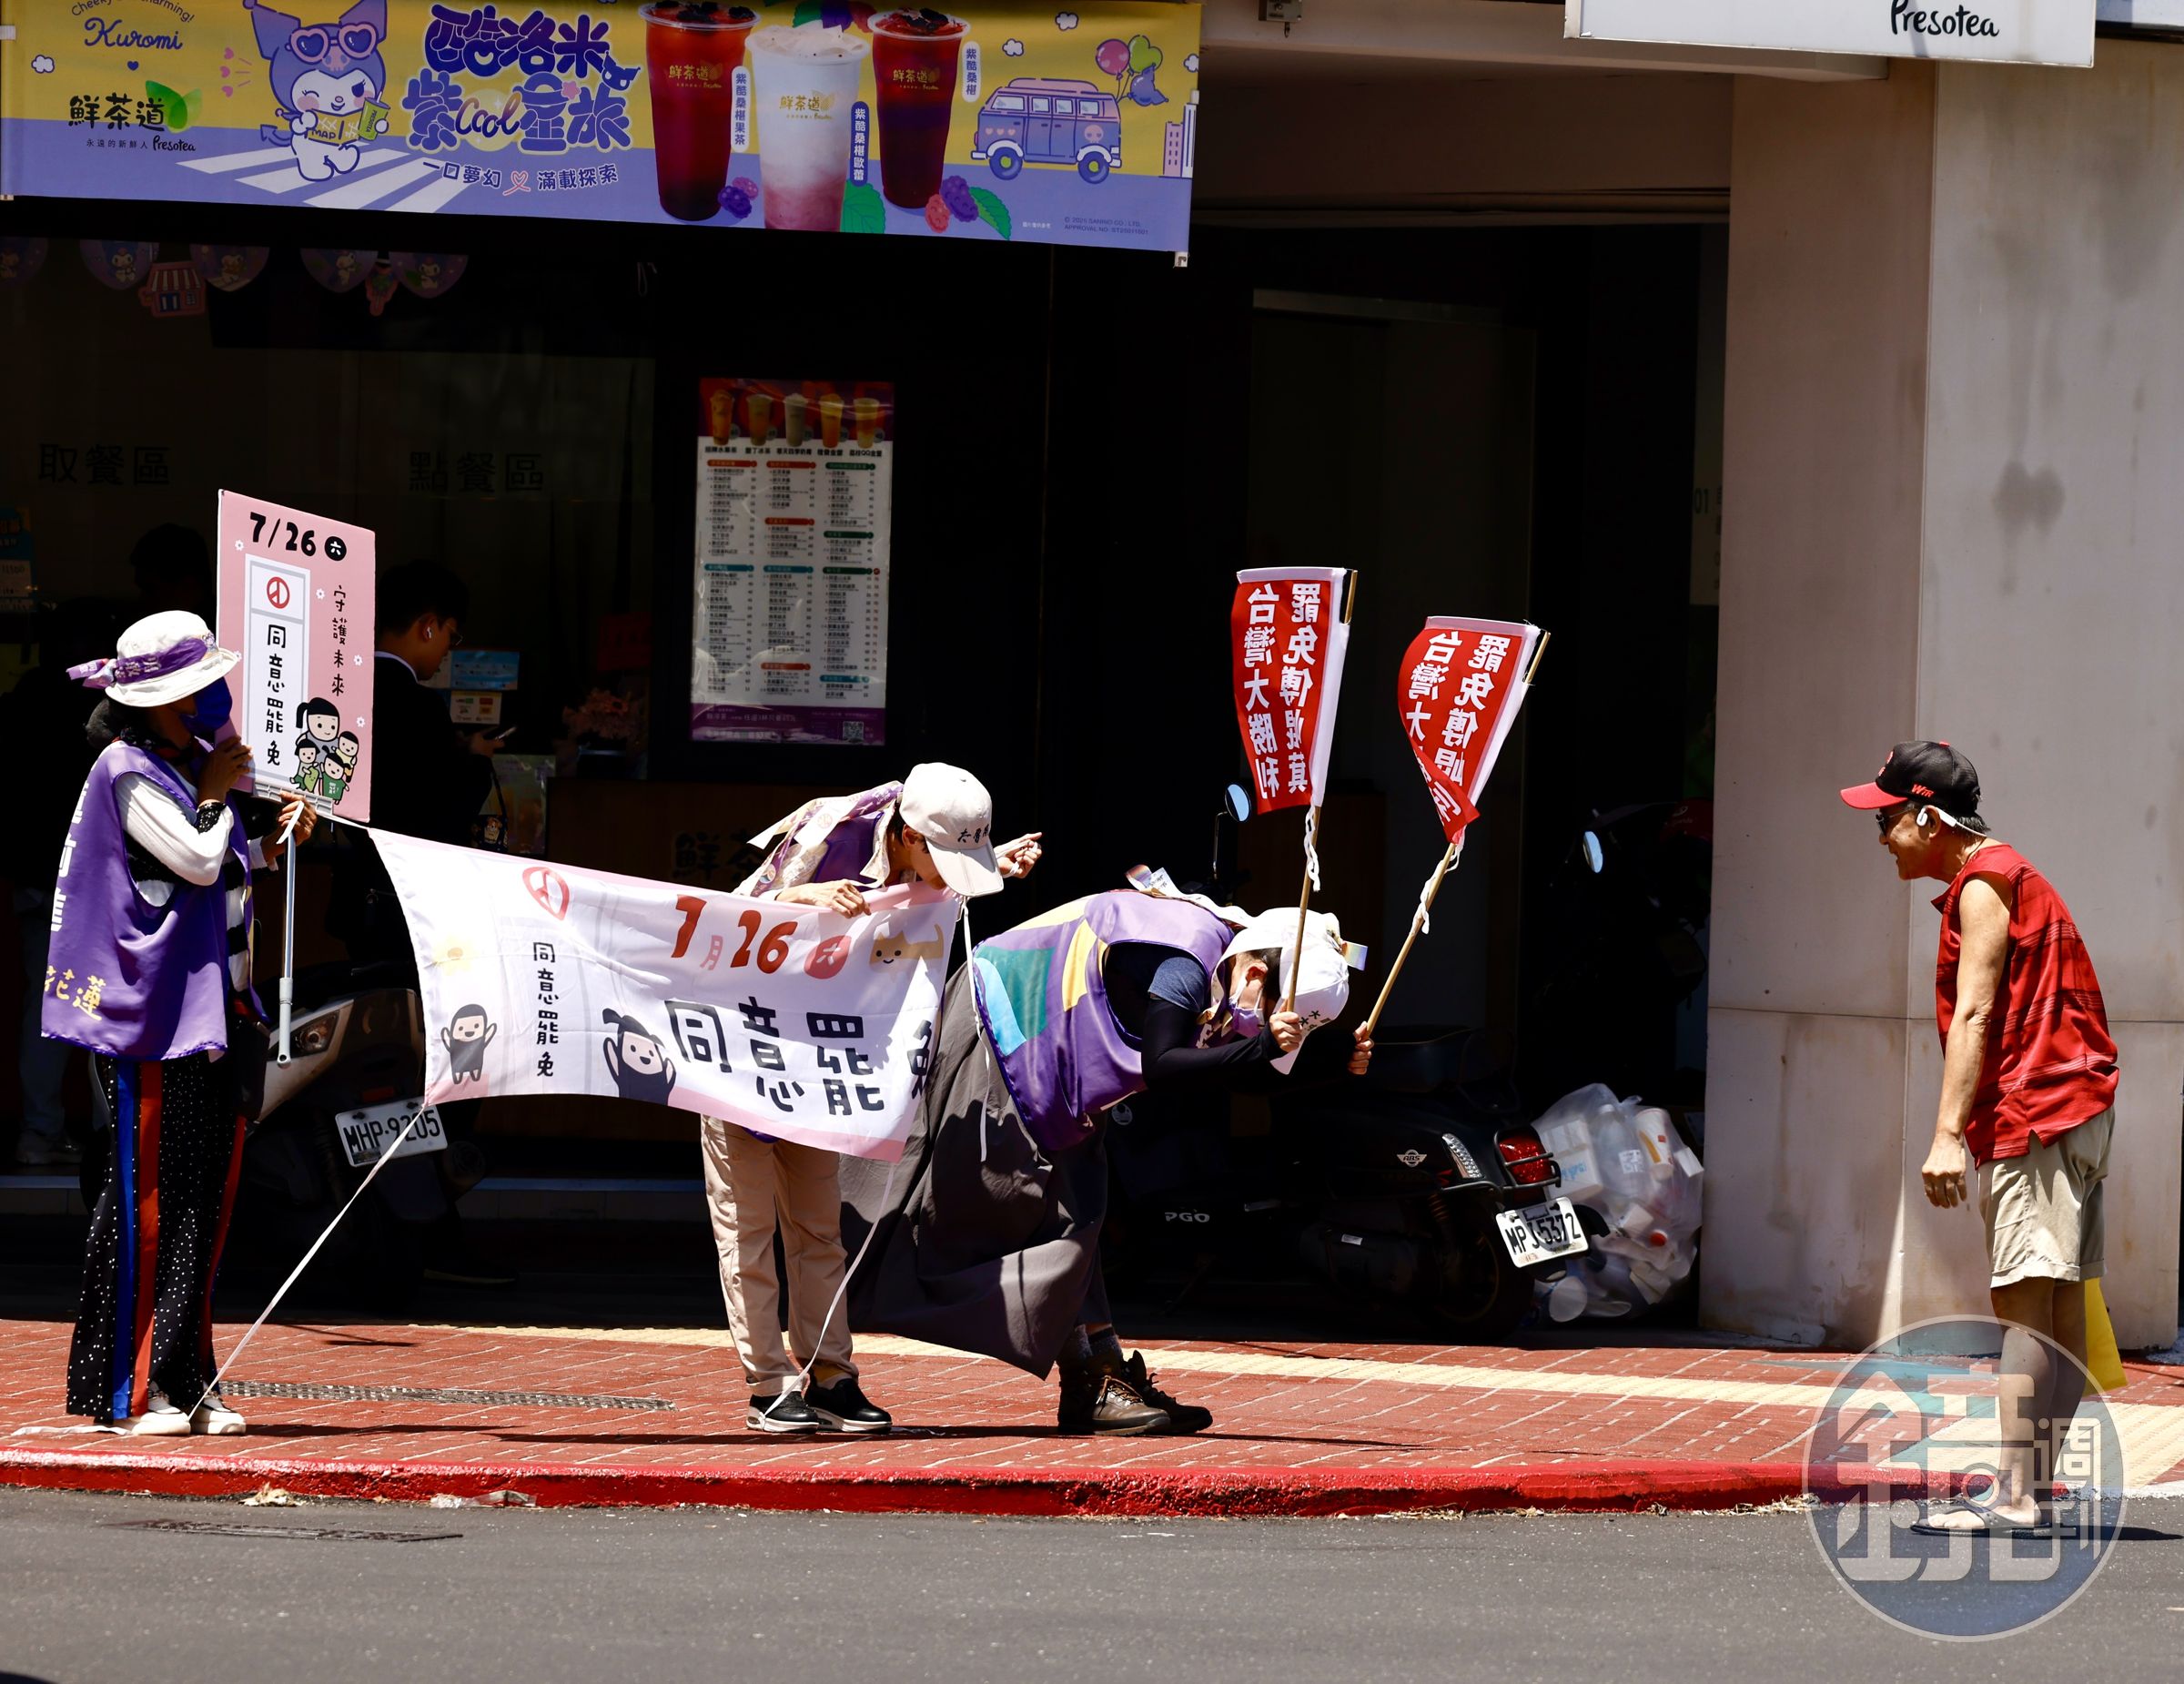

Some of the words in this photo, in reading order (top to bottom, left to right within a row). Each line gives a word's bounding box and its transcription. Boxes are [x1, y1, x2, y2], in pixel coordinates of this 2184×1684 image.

[85, 17, 183, 50] Kuromi
[1891, 0, 1999, 36] Presotea
[425, 5, 610, 78] 酷洛米
[68, 92, 165, 132] 鮮茶道
[153, 134, 197, 151] Presotea
[423, 161, 501, 188] 一口夢幻
[538, 164, 618, 190] 滿載探索
[38, 443, 170, 485] 取餐區
[409, 451, 543, 492] 點餐區
[249, 512, 317, 556] 7/26
[332, 584, 349, 697] 守護未來
[265, 624, 287, 767] 同意罷免
[671, 894, 798, 974] 7月26
[532, 941, 560, 1077] 同意罷免
[1164, 1212, 1210, 1223] PGO
